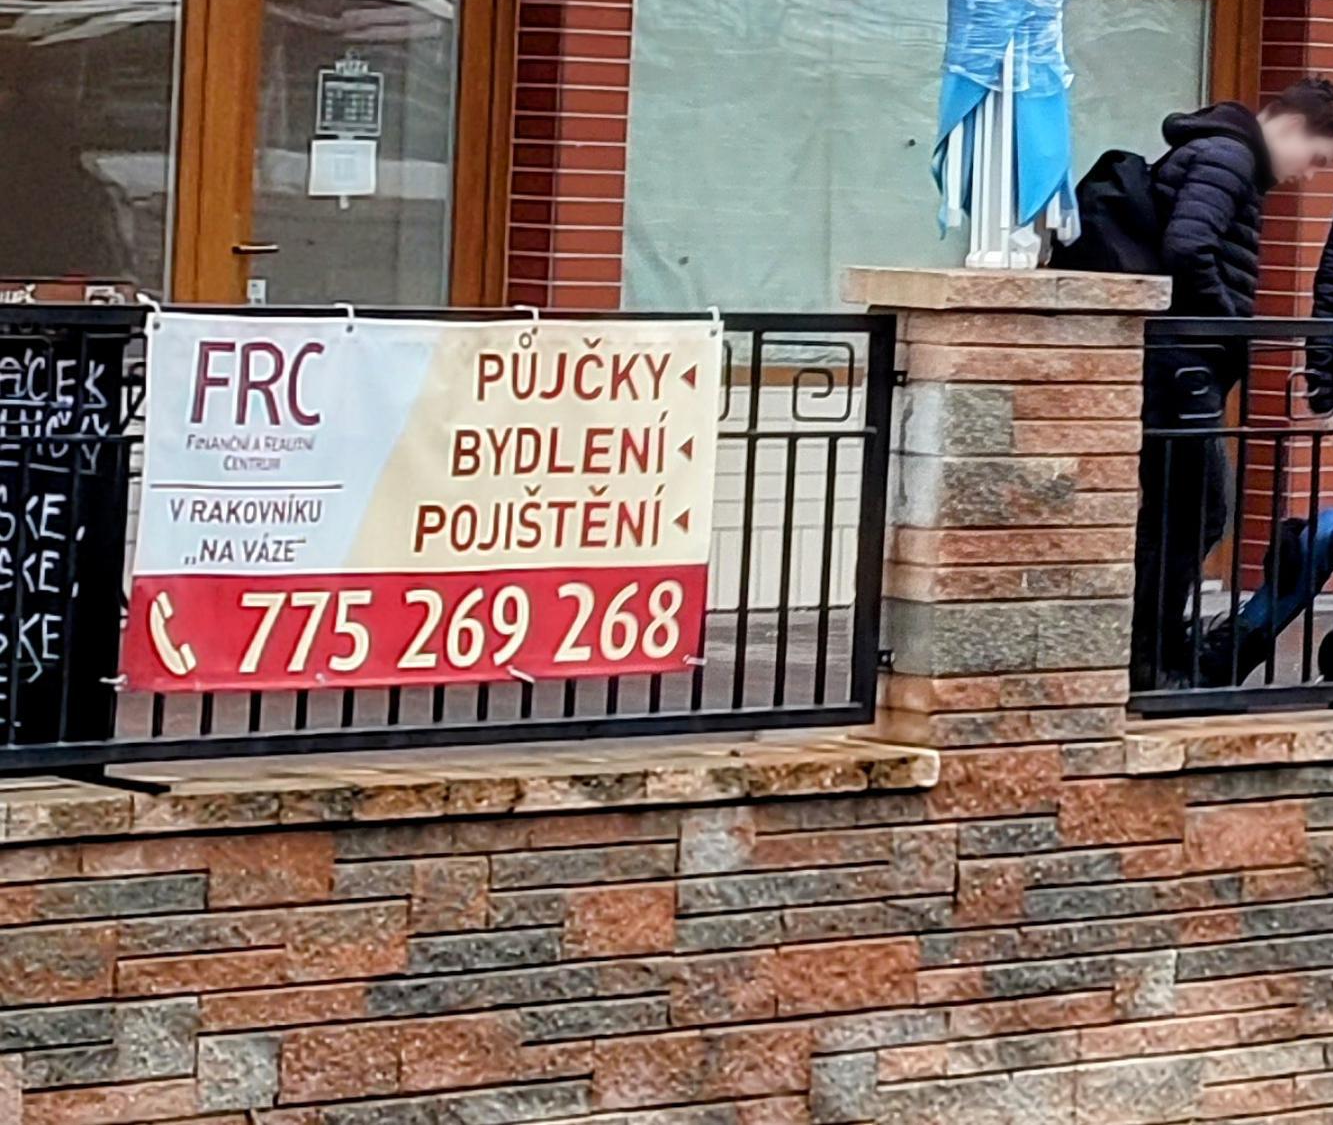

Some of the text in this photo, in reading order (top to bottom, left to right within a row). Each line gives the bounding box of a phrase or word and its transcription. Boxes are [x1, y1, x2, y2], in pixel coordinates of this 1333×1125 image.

[190, 341, 325, 426] FRC
[476, 330, 673, 402] PŮJČKY
[223, 455, 281, 472] CENTRUM
[451, 410, 669, 478] BYDLENÍ
[170, 494, 322, 525] V RAKOVNÍKU
[413, 483, 666, 553] POJIŠTĚNÍ
[238, 579, 684, 674] 775 269 268
